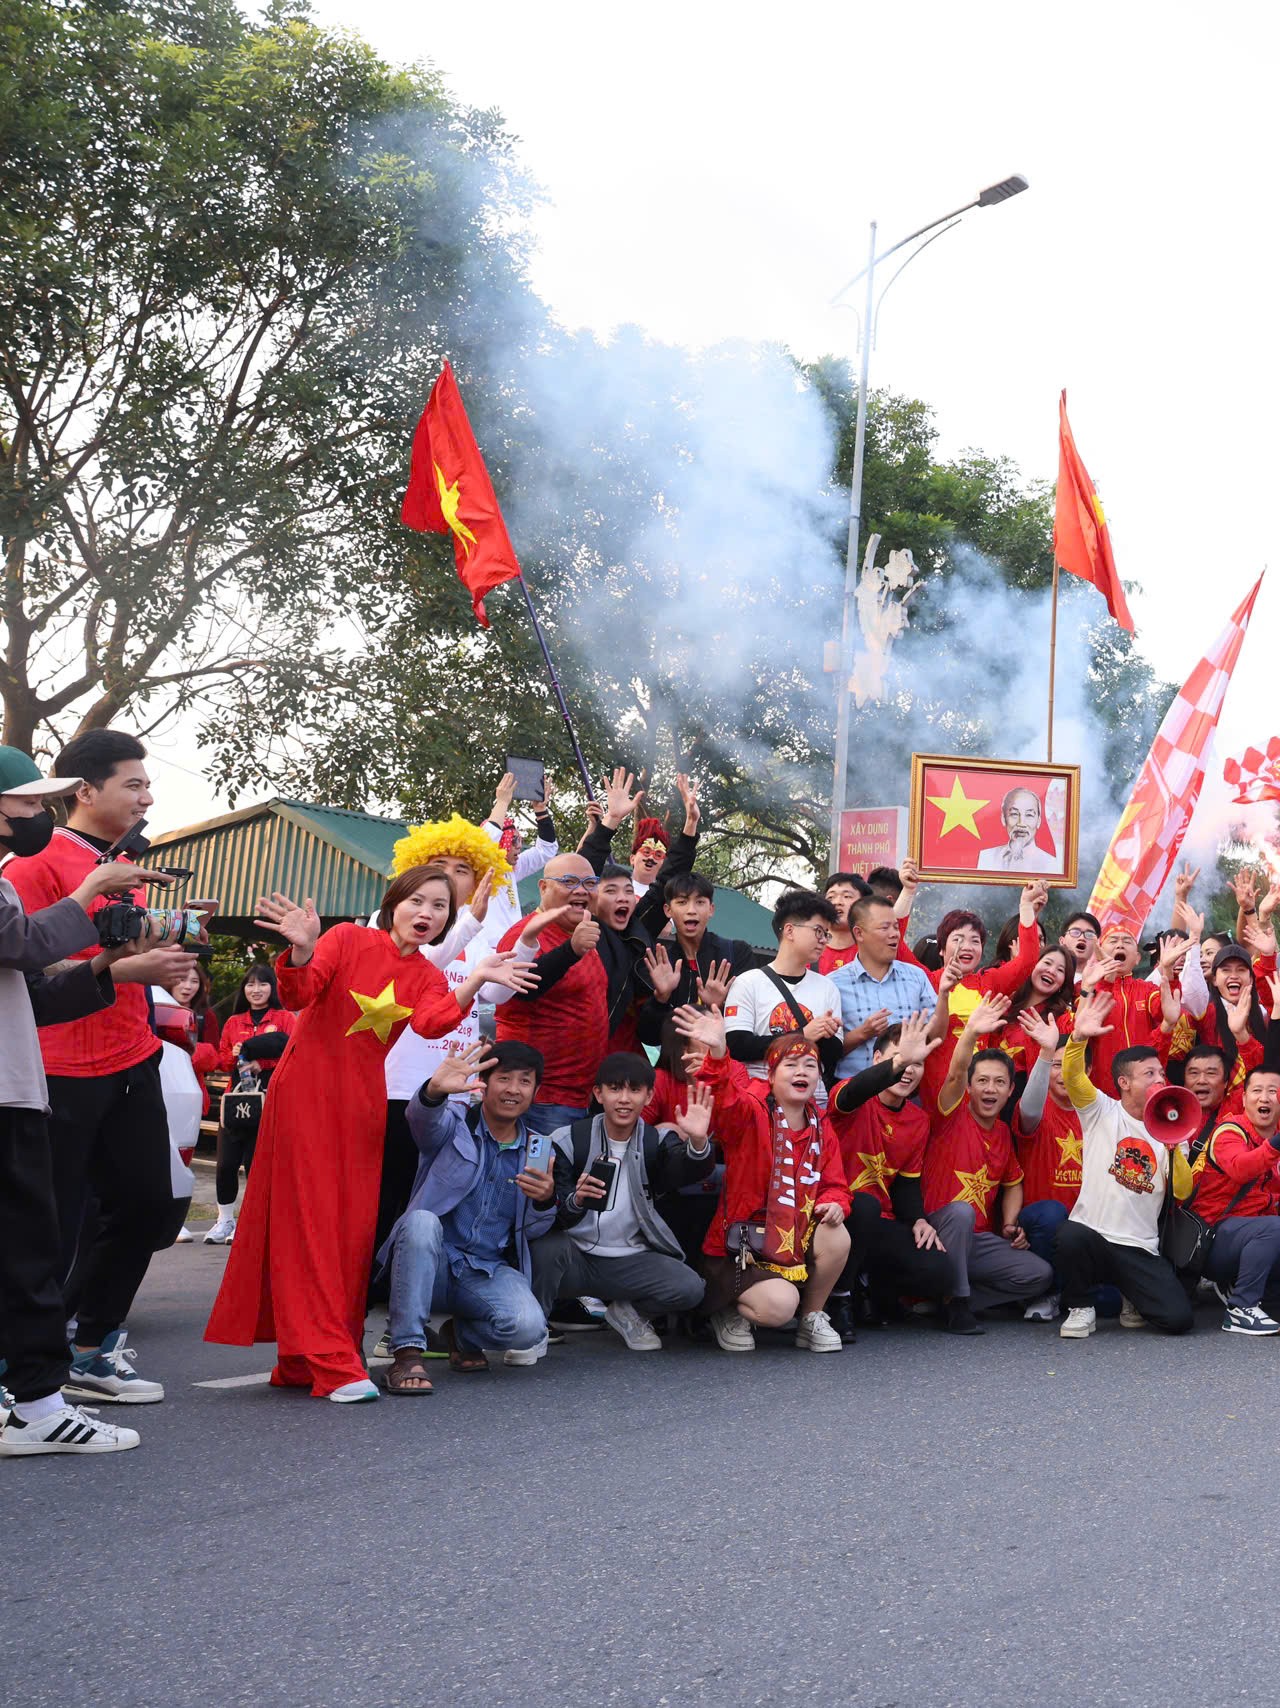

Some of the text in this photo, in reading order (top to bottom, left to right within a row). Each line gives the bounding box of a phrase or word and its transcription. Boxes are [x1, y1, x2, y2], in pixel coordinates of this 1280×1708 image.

[850, 822, 867, 836] XÂY
[847, 841, 873, 856] THÀNH
[235, 1102, 251, 1119] NY
[1055, 1168, 1083, 1182] VIETNA
